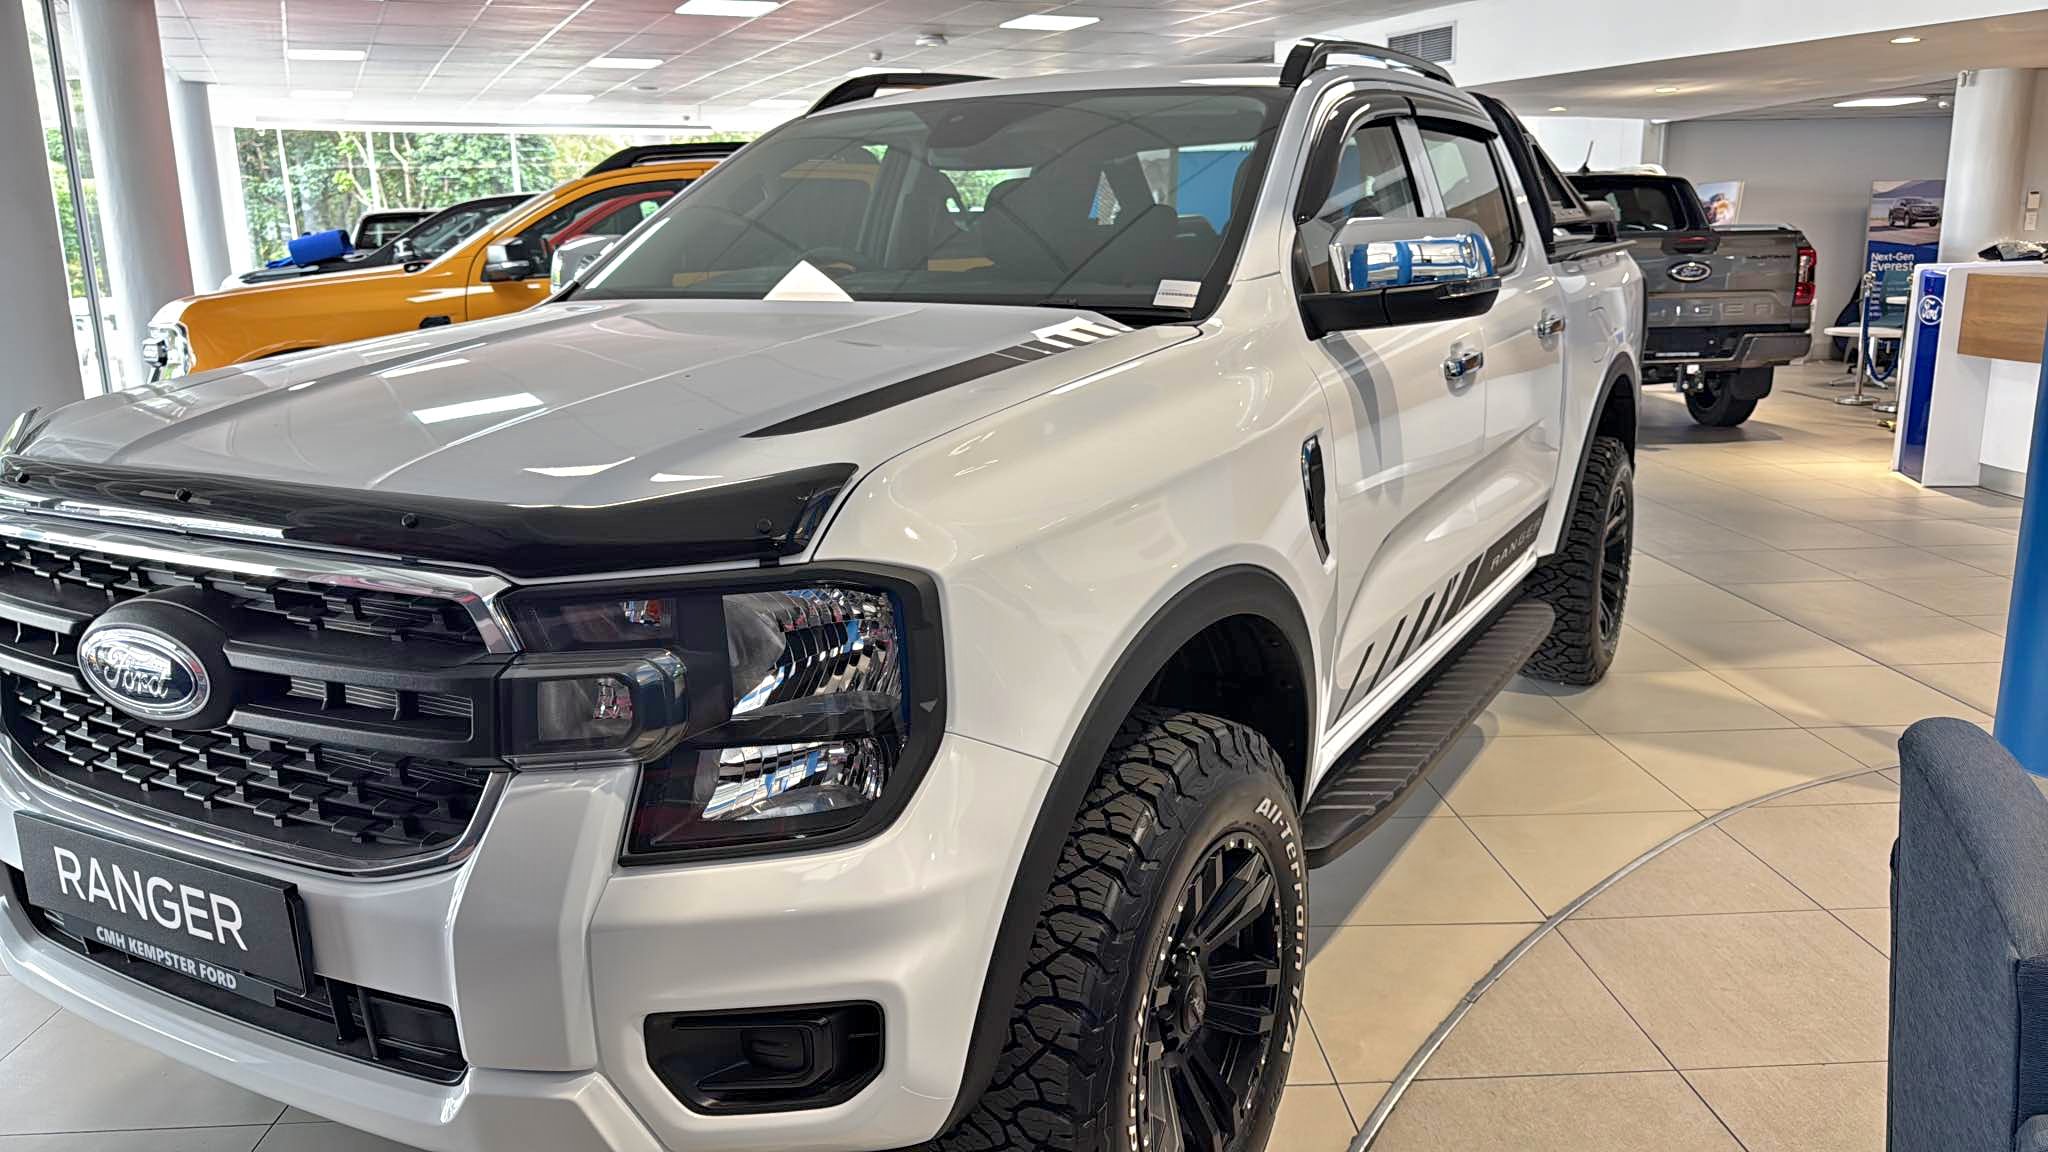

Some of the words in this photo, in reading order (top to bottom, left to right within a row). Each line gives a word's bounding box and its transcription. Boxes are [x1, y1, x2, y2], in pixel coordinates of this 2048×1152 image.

[1870, 261, 1914, 272] Everest
[1871, 252, 1915, 262] Next-Gen
[1922, 298, 1941, 321] Ford
[1490, 517, 1542, 571] RANGER
[103, 646, 173, 699] Ford
[53, 845, 248, 952] RANGER
[1254, 797, 1304, 972] All-Terrain
[96, 926, 126, 950] CMH
[128, 937, 197, 976] KEMPSTER
[199, 962, 237, 990] FORD
